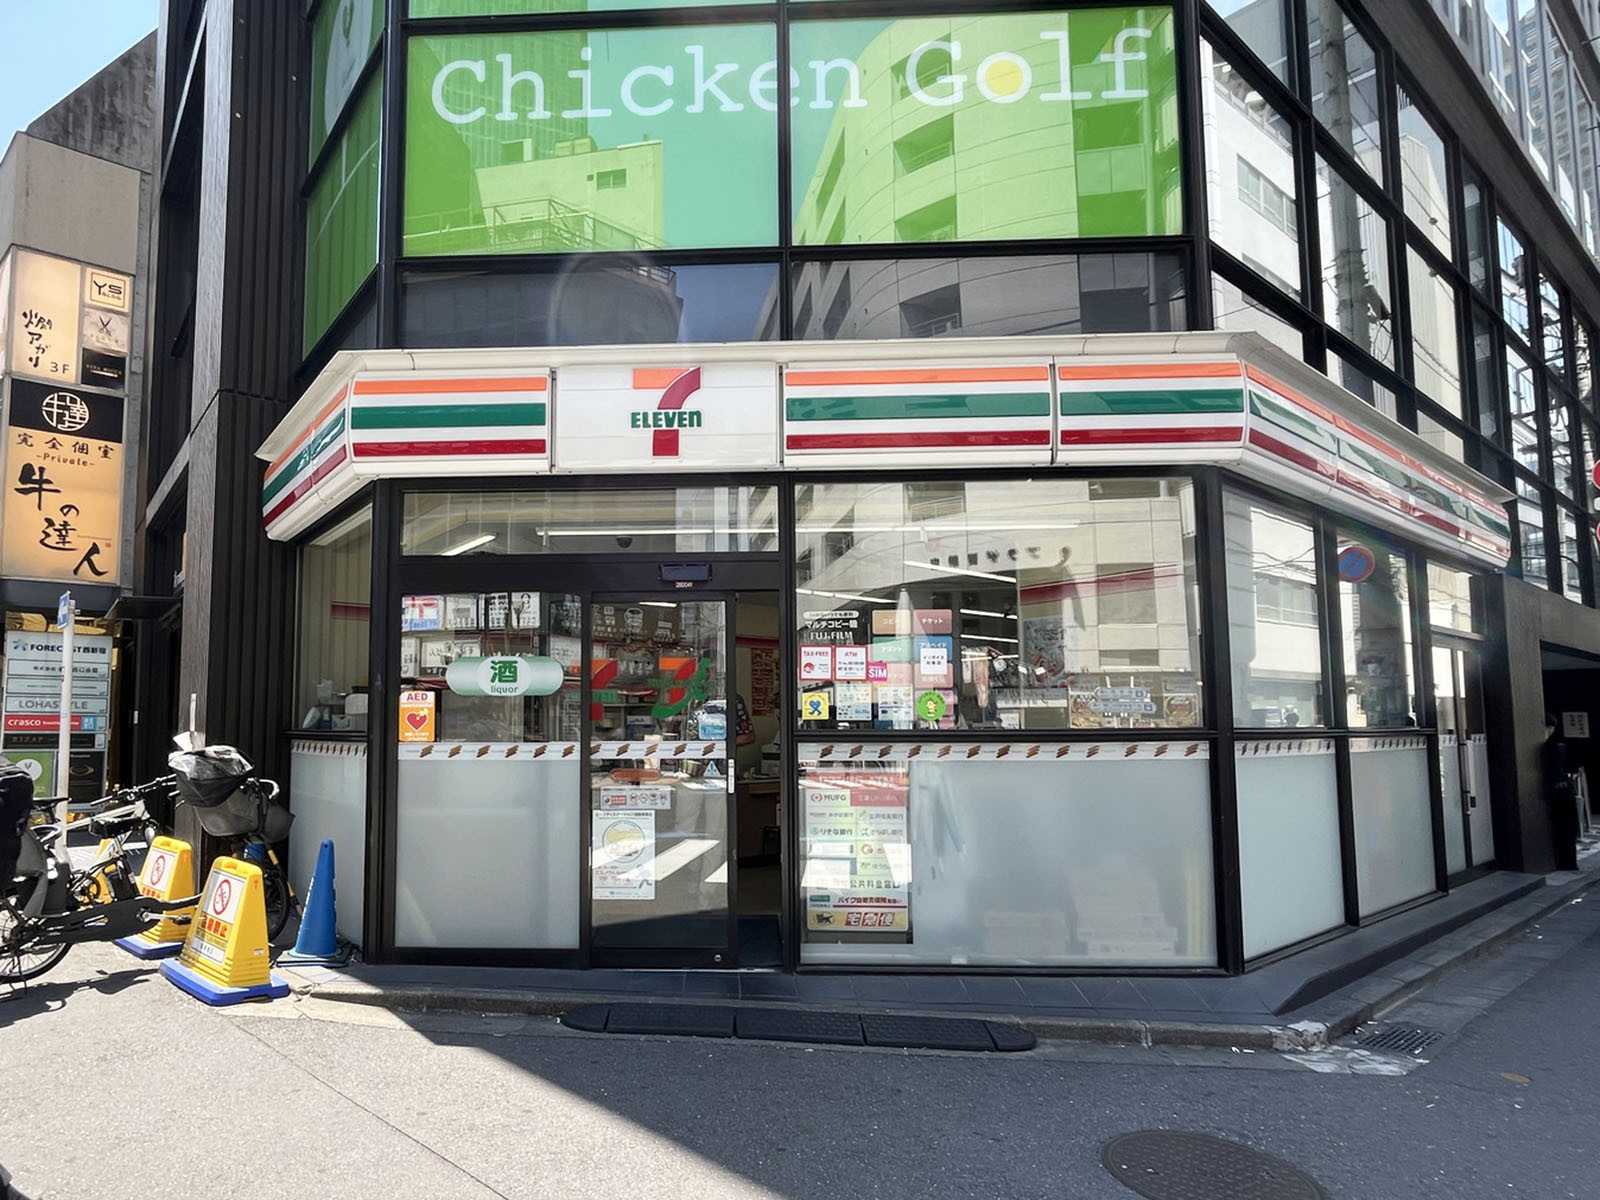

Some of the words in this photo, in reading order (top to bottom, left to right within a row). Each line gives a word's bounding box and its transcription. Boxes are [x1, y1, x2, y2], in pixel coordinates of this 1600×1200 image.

[431, 44, 868, 126] Chicken
[905, 28, 1153, 108] Golf
[15, 433, 115, 459] 完全個室
[14, 463, 110, 577] 牛の達人
[490, 660, 518, 683] 酒
[868, 668, 887, 679] SIM
[490, 685, 519, 695] liquor
[406, 692, 429, 701] AED
[7, 719, 41, 727] crasco
[820, 828, 853, 836] りそな銀行
[846, 912, 895, 926] 宅急便
